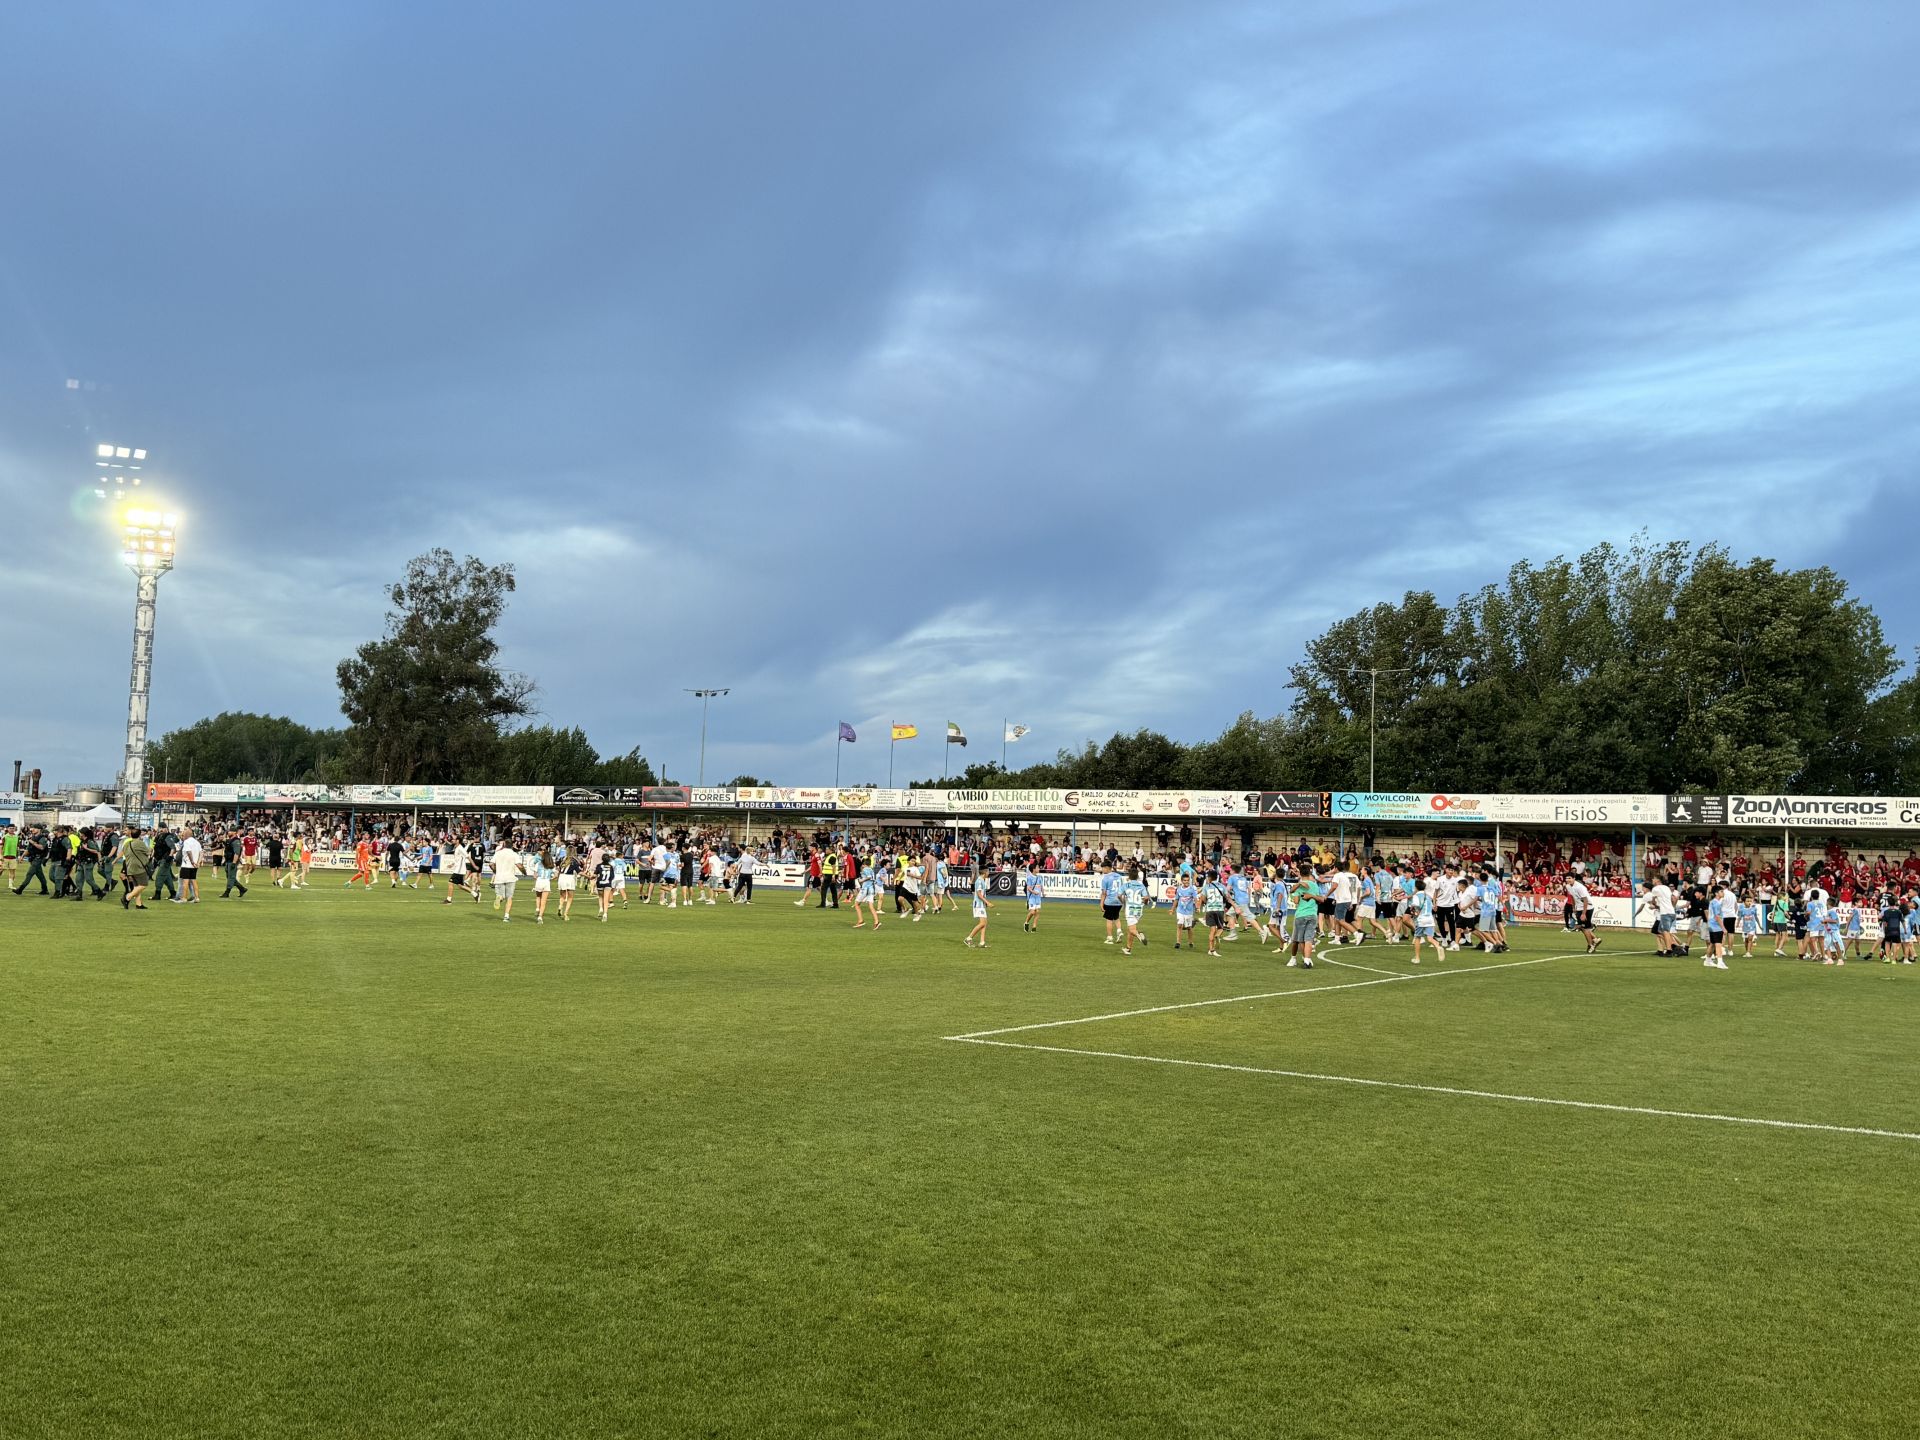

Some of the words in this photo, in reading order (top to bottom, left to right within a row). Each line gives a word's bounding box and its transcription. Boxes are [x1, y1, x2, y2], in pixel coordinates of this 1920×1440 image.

[948, 791, 988, 801] CAMBIO
[992, 791, 1059, 802] ENERGETICO
[782, 801, 832, 809] VALDEPEÑAS
[1555, 806, 1608, 821] FisioS
